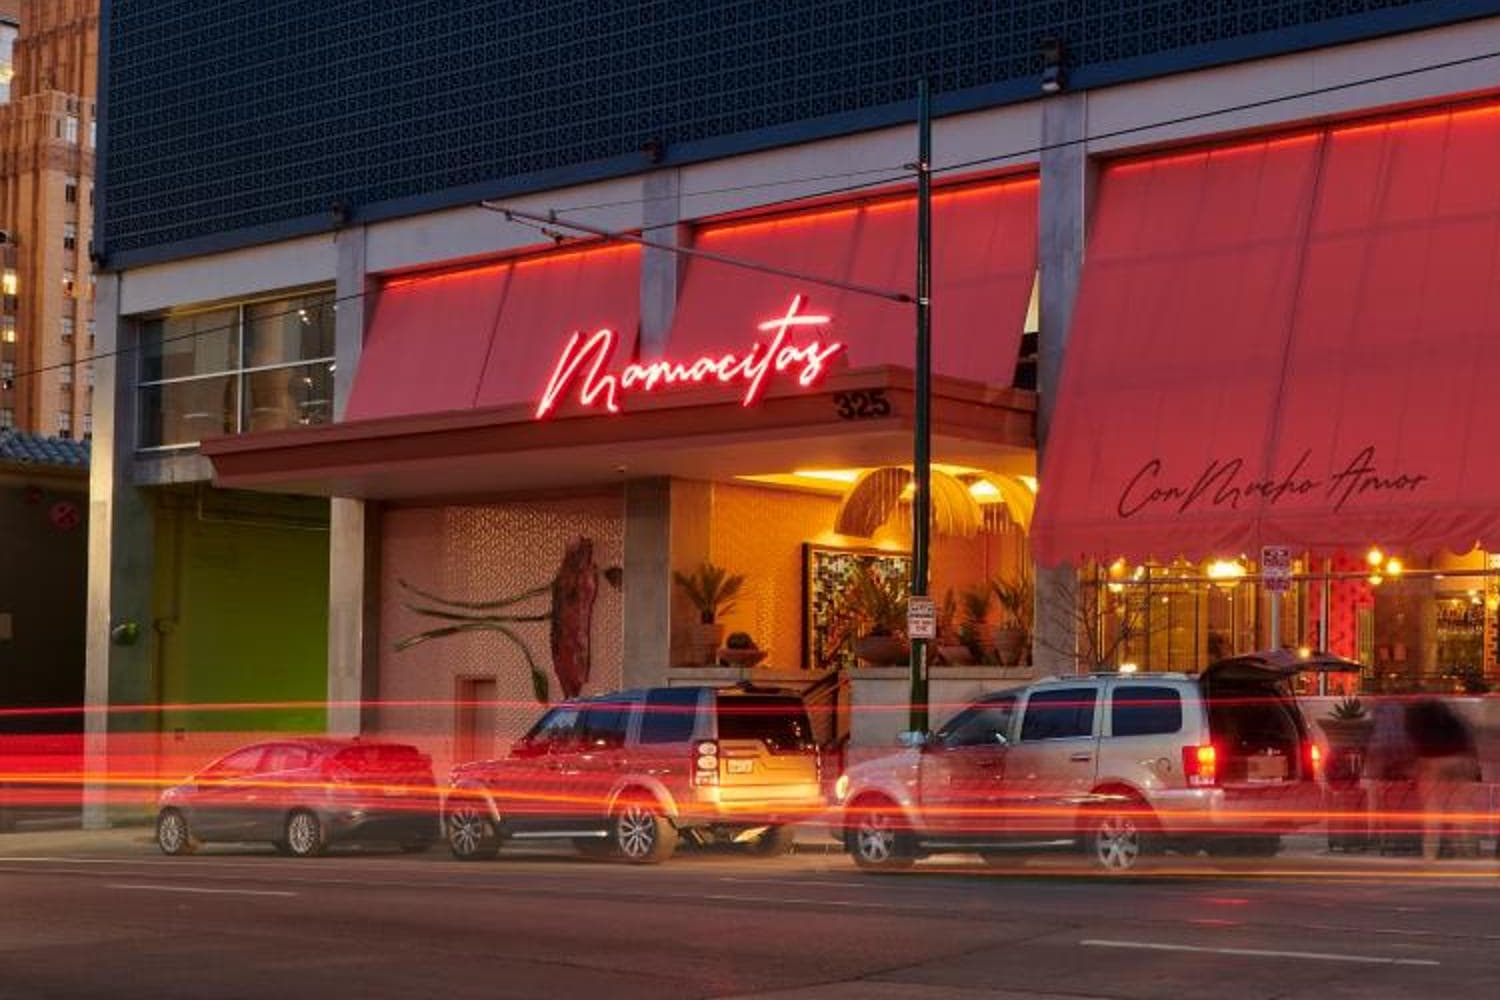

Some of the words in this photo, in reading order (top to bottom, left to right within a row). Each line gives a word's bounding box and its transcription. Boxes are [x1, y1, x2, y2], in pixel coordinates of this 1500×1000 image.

[534, 293, 843, 421] Mamacitas
[833, 390, 891, 420] 325
[1117, 458, 1187, 519] Con
[1328, 445, 1429, 514] Amor
